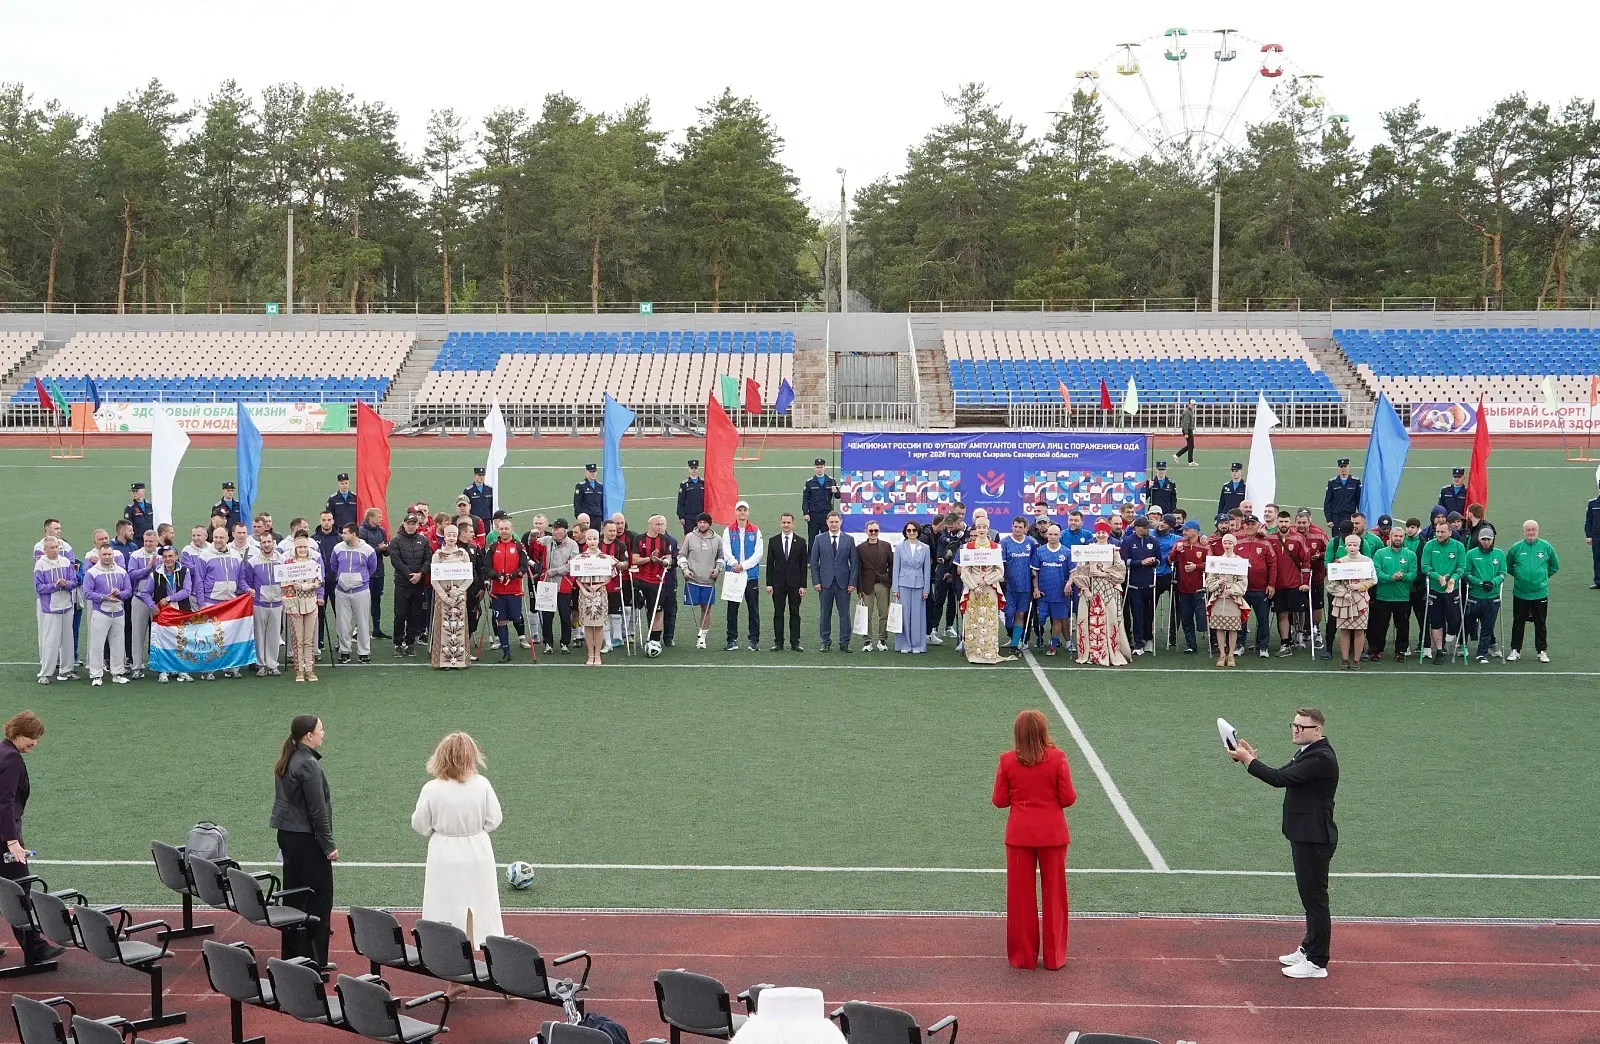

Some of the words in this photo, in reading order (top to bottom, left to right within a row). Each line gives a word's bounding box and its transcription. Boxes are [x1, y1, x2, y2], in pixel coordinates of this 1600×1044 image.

[132, 405, 200, 418] ЗДООВЫЙ
[203, 407, 237, 416] ОБРА
[1484, 405, 1538, 416] ВЫБИРАЙ
[177, 419, 200, 428] ЭТО
[202, 419, 238, 430] МОДН
[1509, 417, 1565, 428] ВЫБИРАЙ
[1047, 442, 1062, 450] ЛИЦ
[1070, 442, 1122, 450] ПОРАЖЕНИЕМ
[1123, 443, 1139, 451] ОДА
[982, 451, 1012, 459] Сызрань
[1013, 451, 1050, 459] Самарской
[1051, 451, 1079, 459] области
